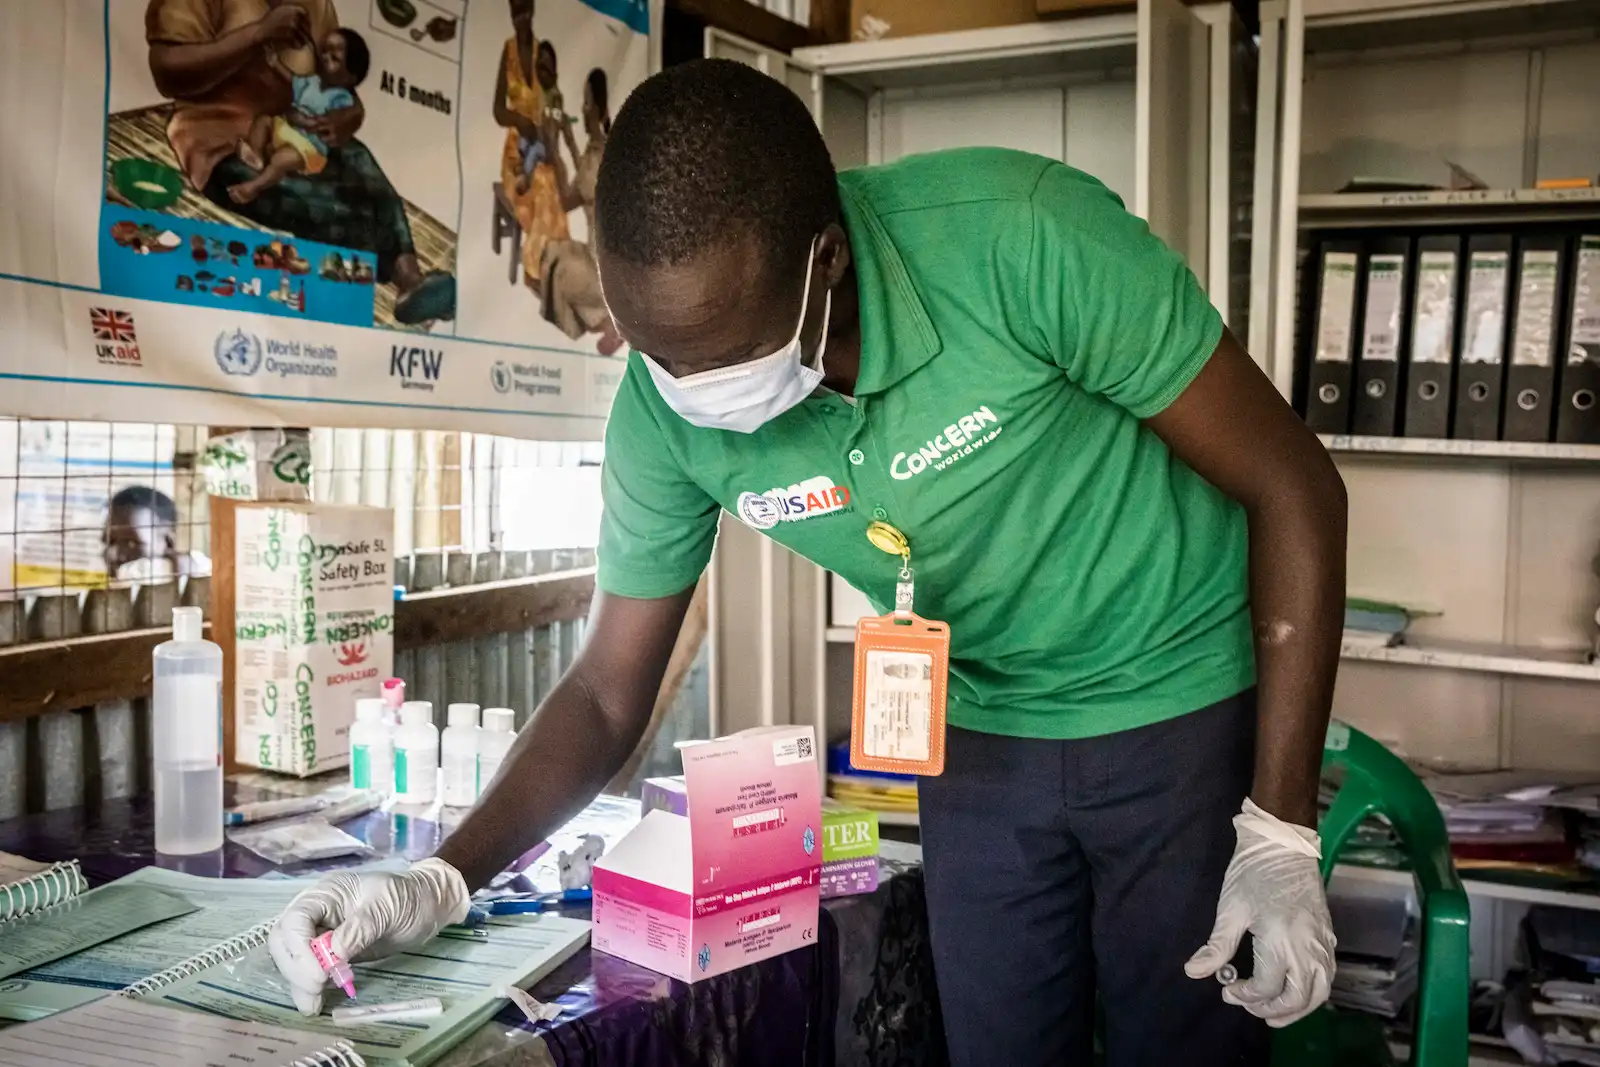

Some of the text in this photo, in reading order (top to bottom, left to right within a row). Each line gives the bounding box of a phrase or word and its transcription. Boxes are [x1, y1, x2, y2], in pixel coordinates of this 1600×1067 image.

[380, 69, 451, 115] At 6 months
[265, 338, 338, 361] World Health
[265, 357, 337, 378] Organization
[512, 363, 561, 380] World Food
[401, 378, 434, 392] Germany
[513, 380, 561, 397] Programme
[890, 405, 998, 480] CONCERN
[776, 486, 850, 515] USAID
[319, 560, 386, 582] Safety Box
[326, 667, 379, 687] BIOHAZARD
[296, 662, 318, 769] CONCERN
[755, 796, 777, 805] Antigen
[778, 792, 798, 801] Malaria
